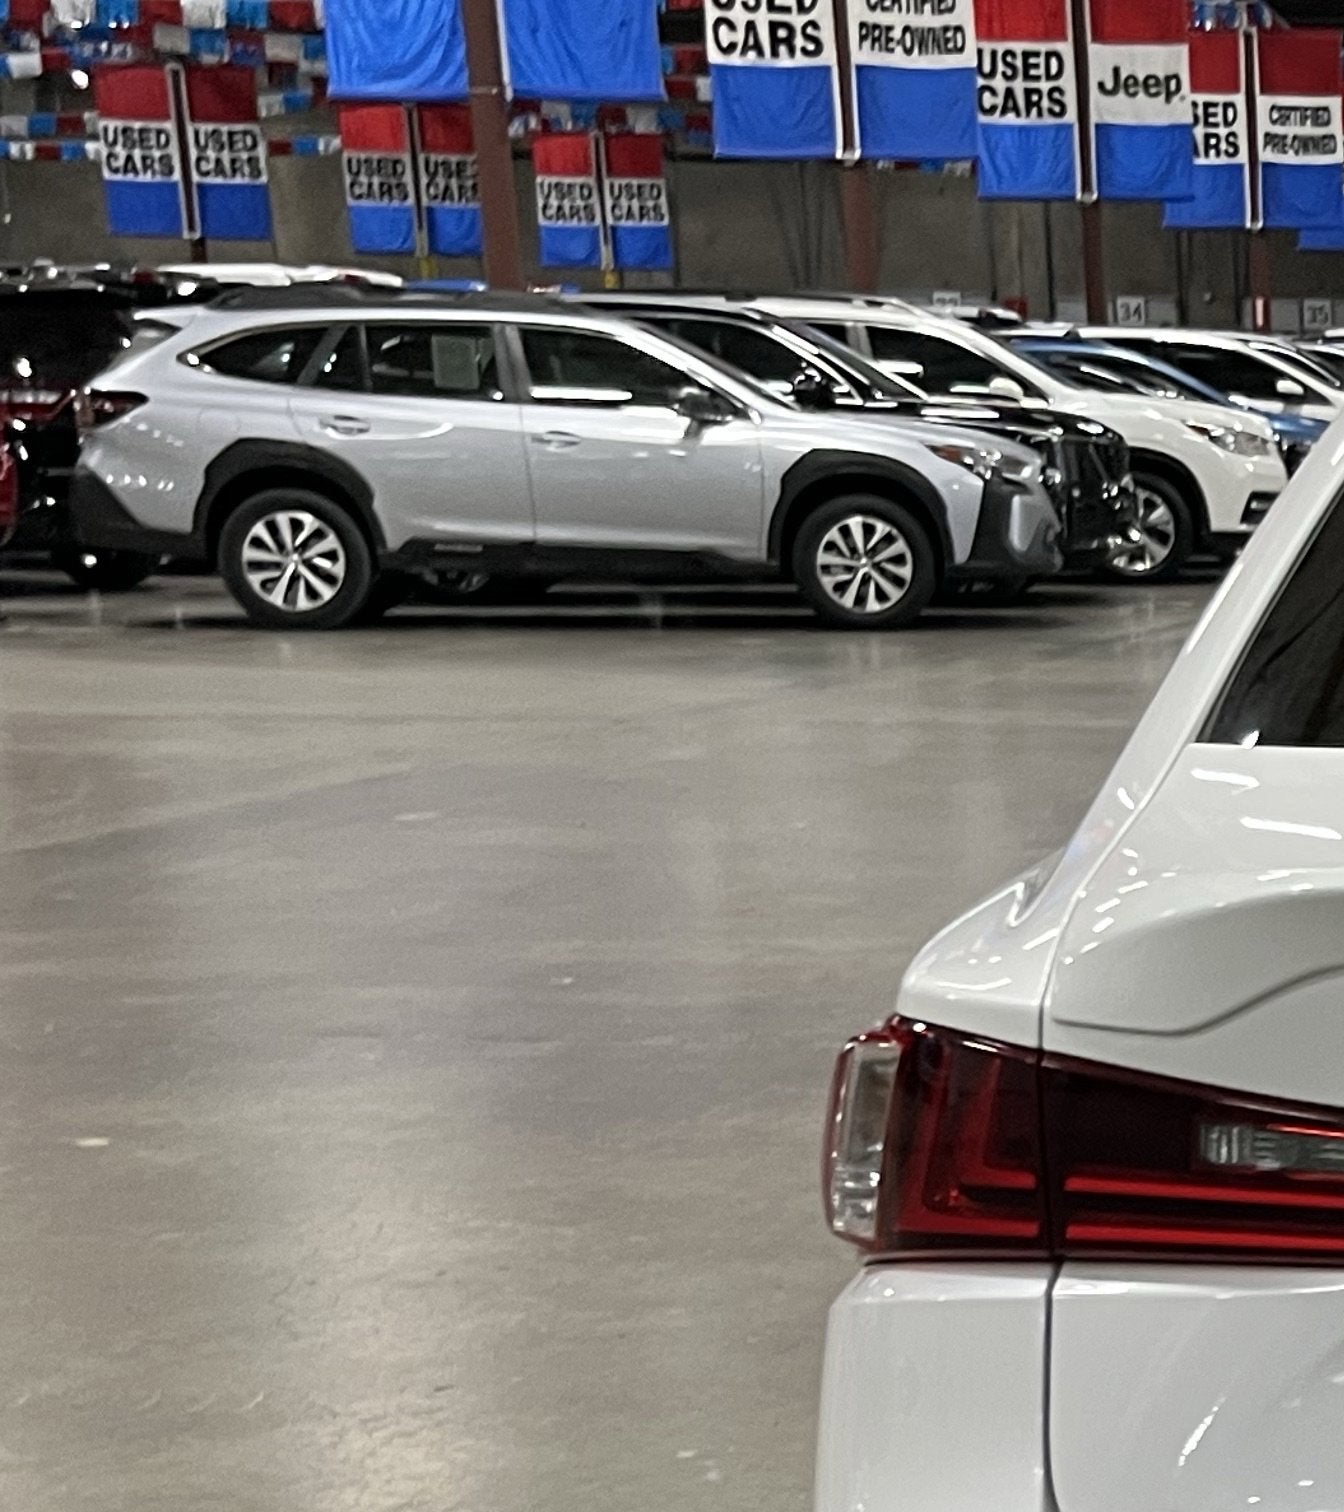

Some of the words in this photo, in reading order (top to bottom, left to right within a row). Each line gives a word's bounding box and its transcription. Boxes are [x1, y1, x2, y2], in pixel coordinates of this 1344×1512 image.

[712, 17, 823, 59] CARS
[859, 22, 966, 56] PRE-OWNED
[977, 47, 1064, 81] USED
[1098, 65, 1182, 104] Jeep
[977, 85, 1068, 118] CARS
[1269, 104, 1332, 127] CERTIFIED
[102, 125, 171, 152] USED
[193, 128, 259, 154] USED
[1262, 131, 1338, 156] PRE-OWNED
[106, 152, 175, 178] CARS
[195, 155, 261, 179] CARS
[347, 156, 405, 179] USED
[348, 180, 409, 202] CARS
[541, 180, 592, 200] USED
[609, 180, 662, 200] USED
[541, 201, 596, 221] CARS
[611, 201, 666, 222] CARS
